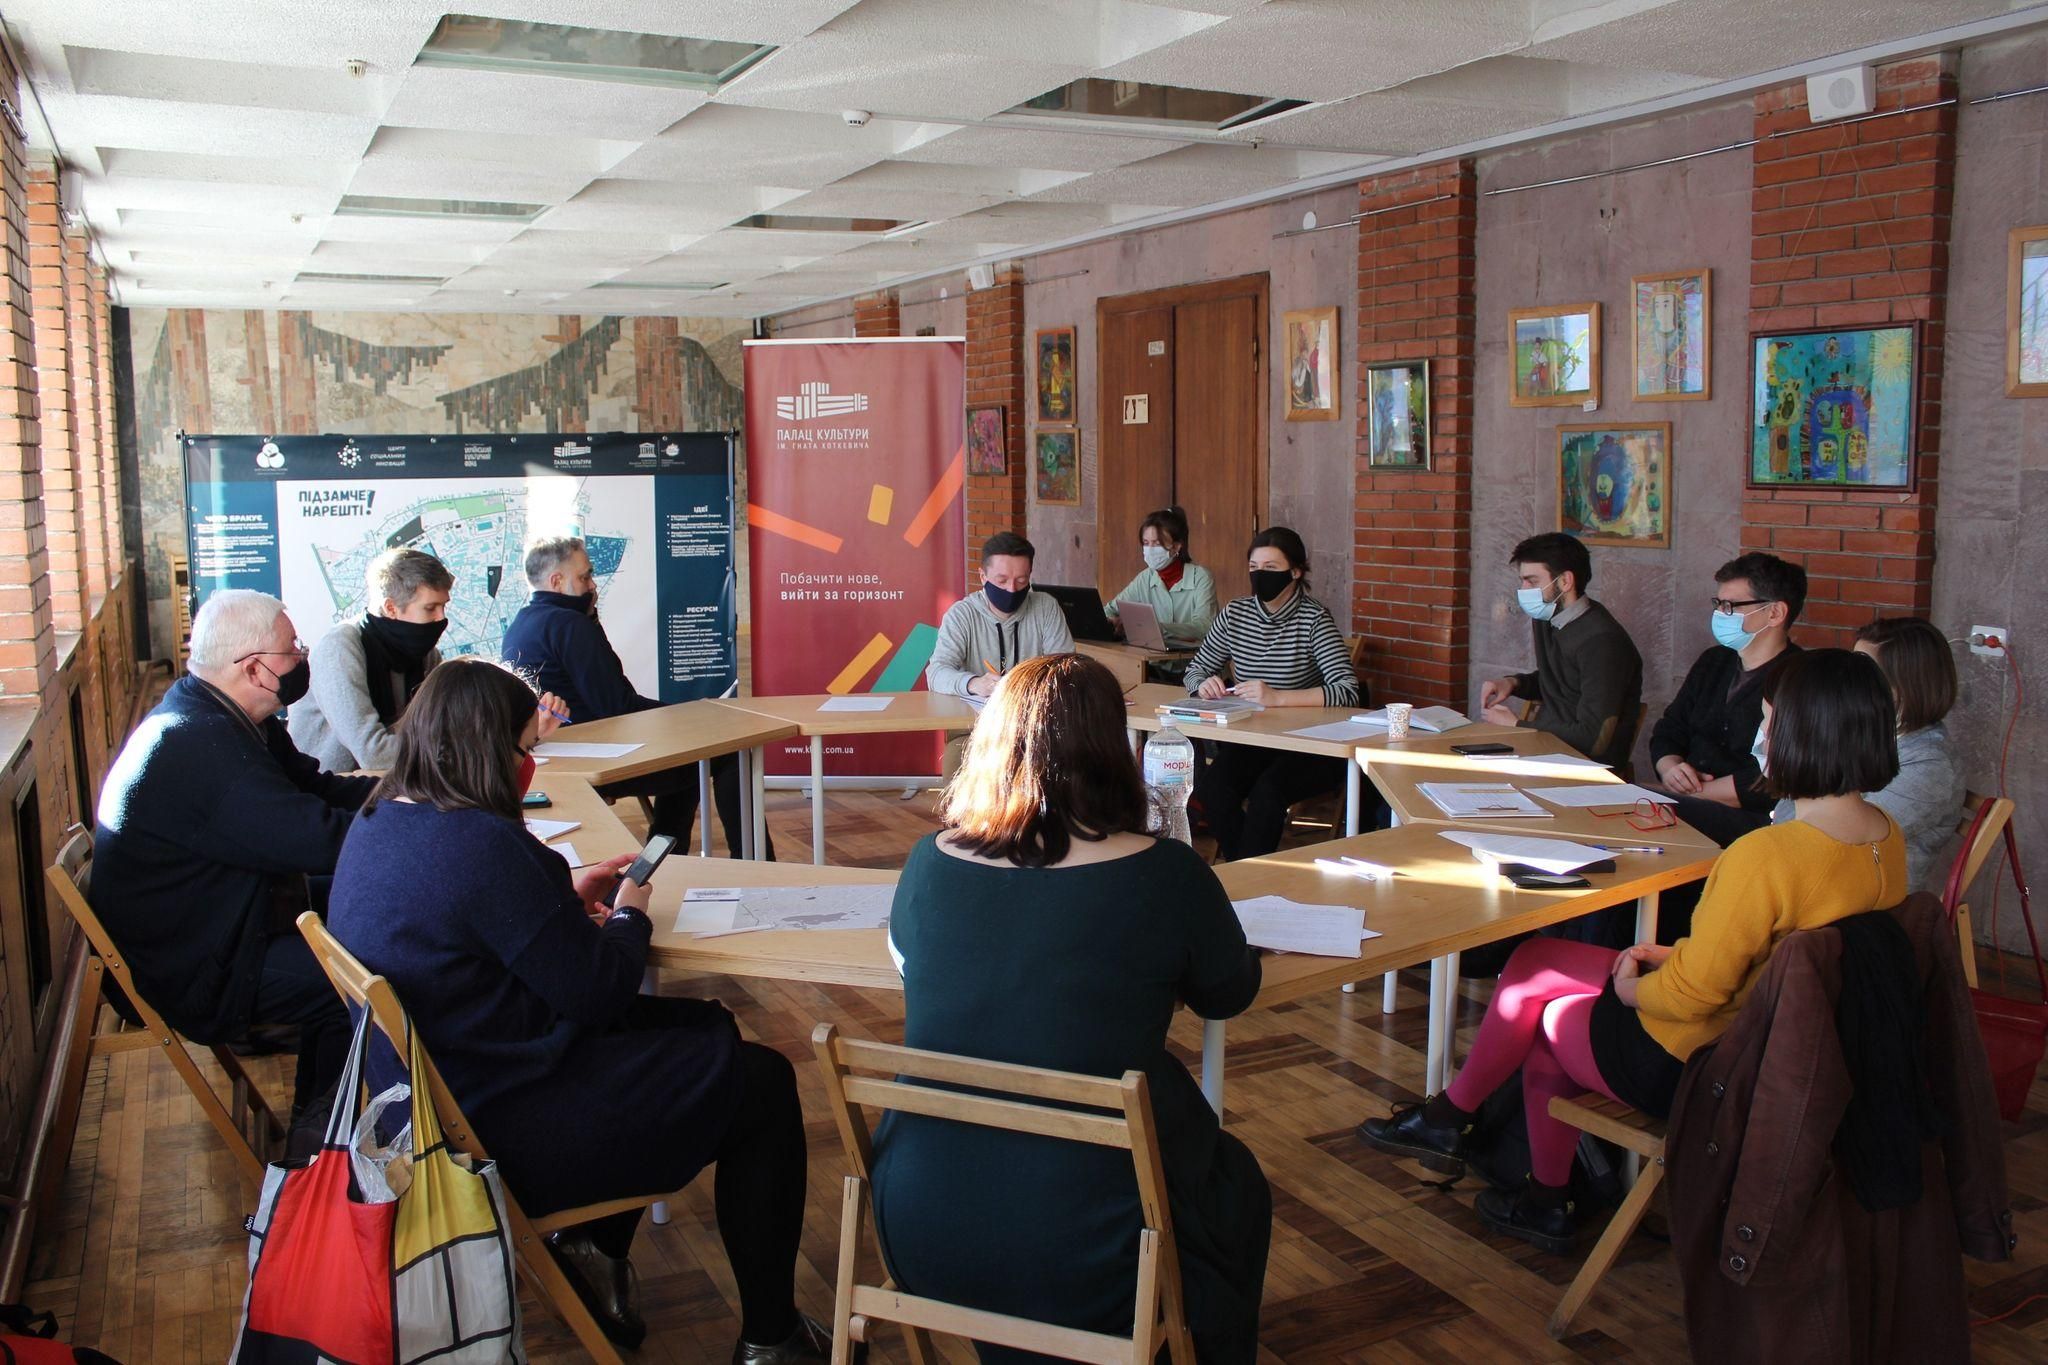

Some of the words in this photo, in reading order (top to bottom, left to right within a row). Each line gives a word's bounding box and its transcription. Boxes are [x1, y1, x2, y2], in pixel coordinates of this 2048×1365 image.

[777, 429, 812, 442] ПАЛАЦ
[816, 428, 869, 440] КУЛЬТУРИ
[298, 489, 366, 504] ПІДЗАМЧЕ
[780, 571, 843, 585] Побачити
[848, 574, 883, 585] нове,
[780, 588, 819, 601] вийти
[824, 591, 839, 601] за
[844, 590, 904, 602] горизонт
